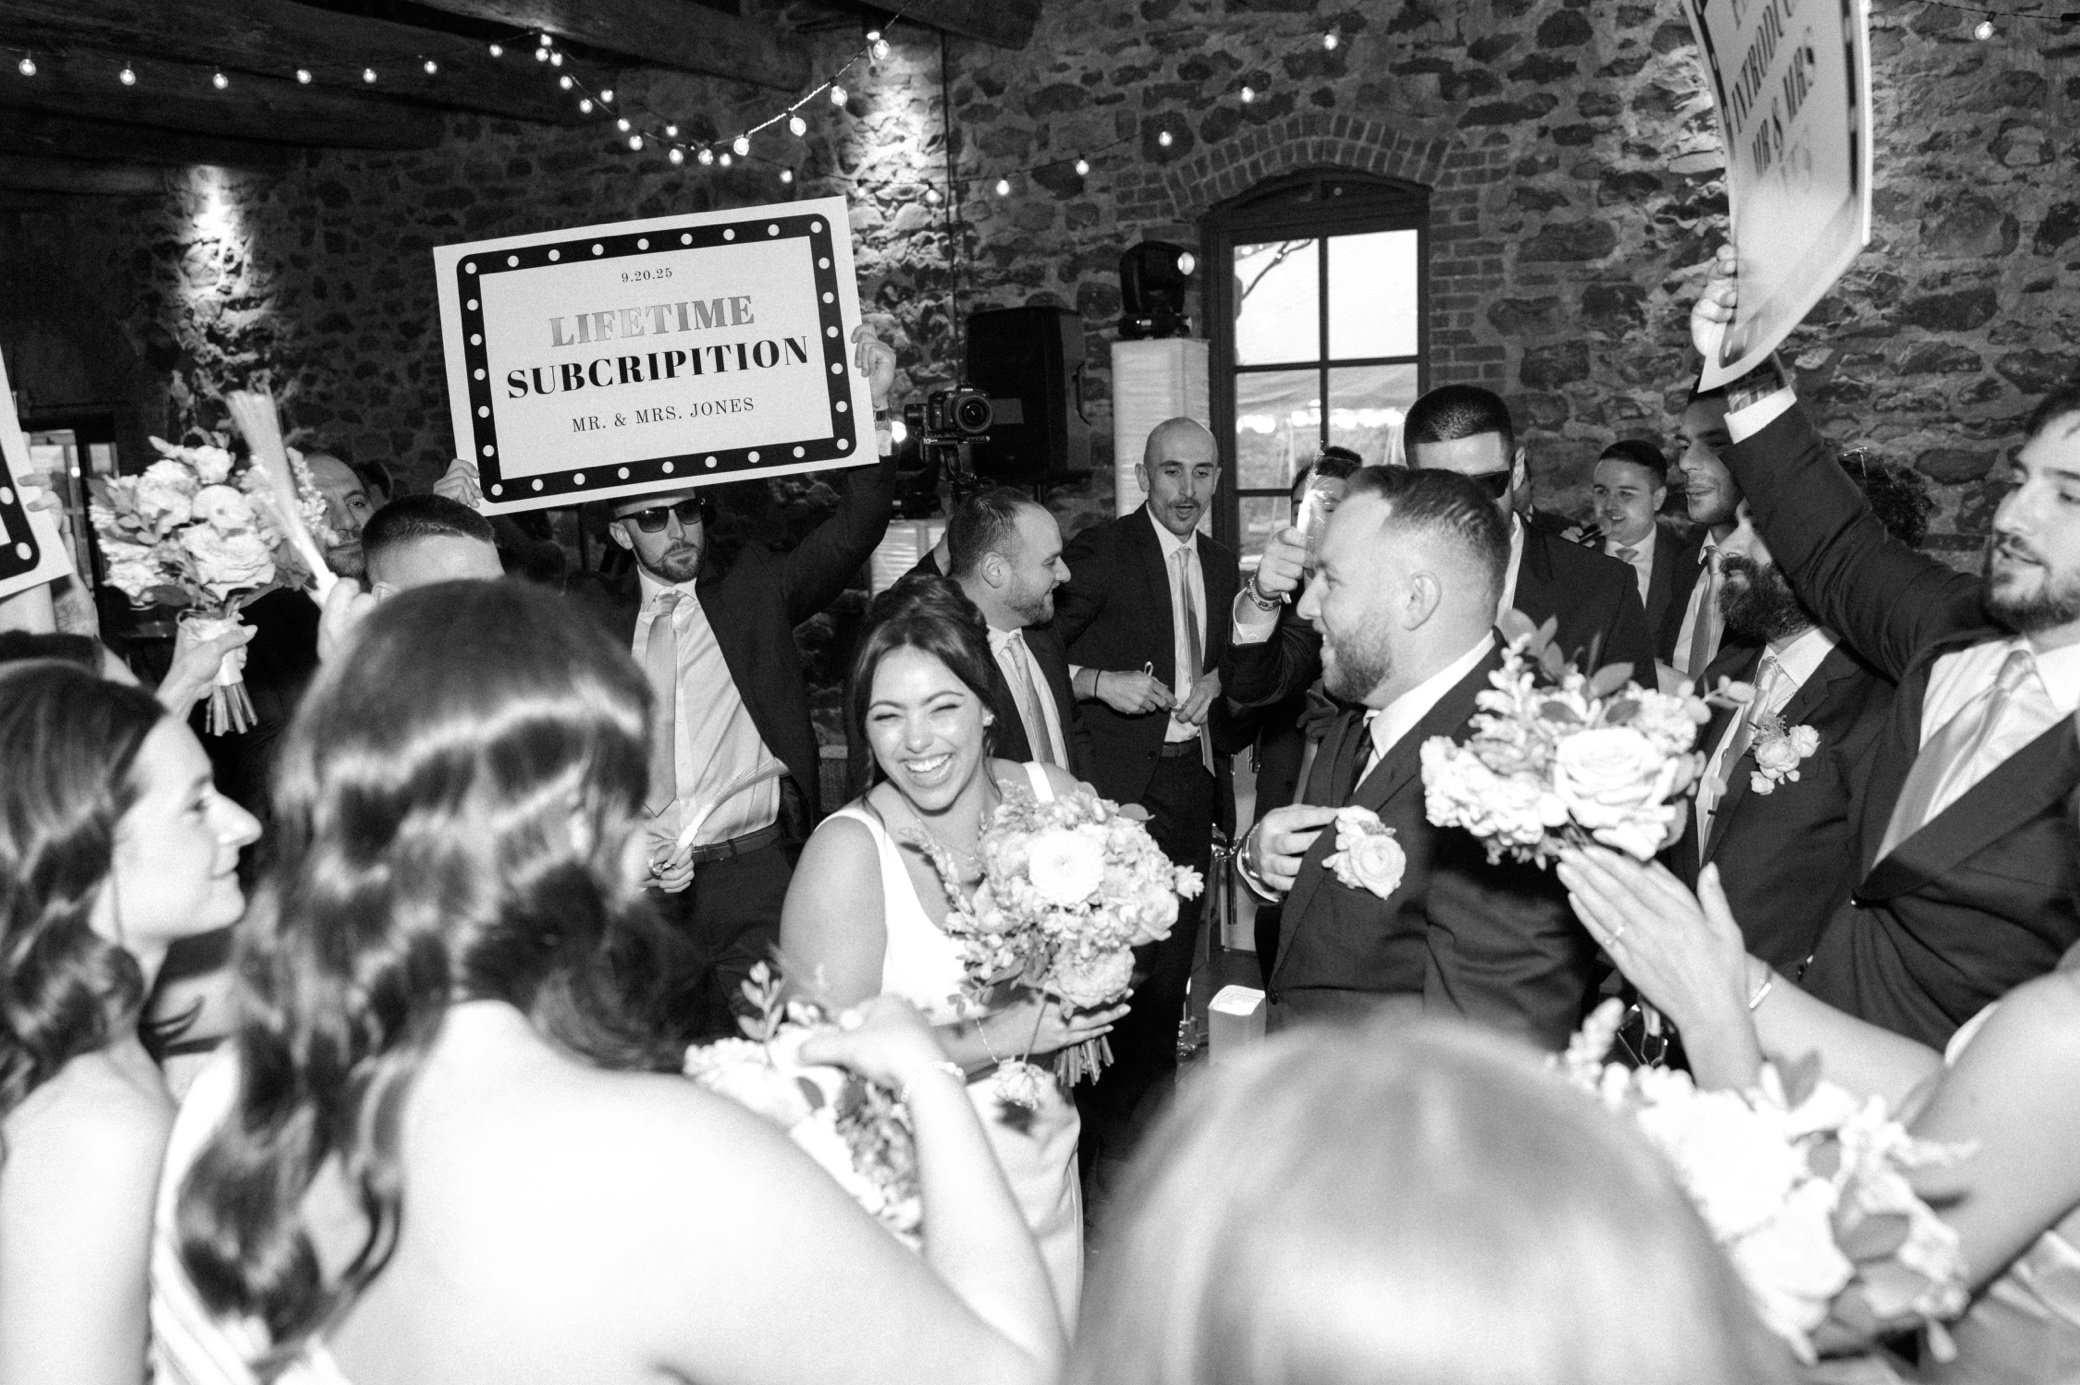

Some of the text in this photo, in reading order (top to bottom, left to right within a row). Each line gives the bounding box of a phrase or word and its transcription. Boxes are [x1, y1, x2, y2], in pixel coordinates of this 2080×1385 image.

[621, 267, 673, 283] 9.20.25
[549, 295, 755, 347] LIFETIME
[506, 336, 809, 399] SUBCRIPITION
[572, 397, 754, 433] MR. & MRS. JONES
